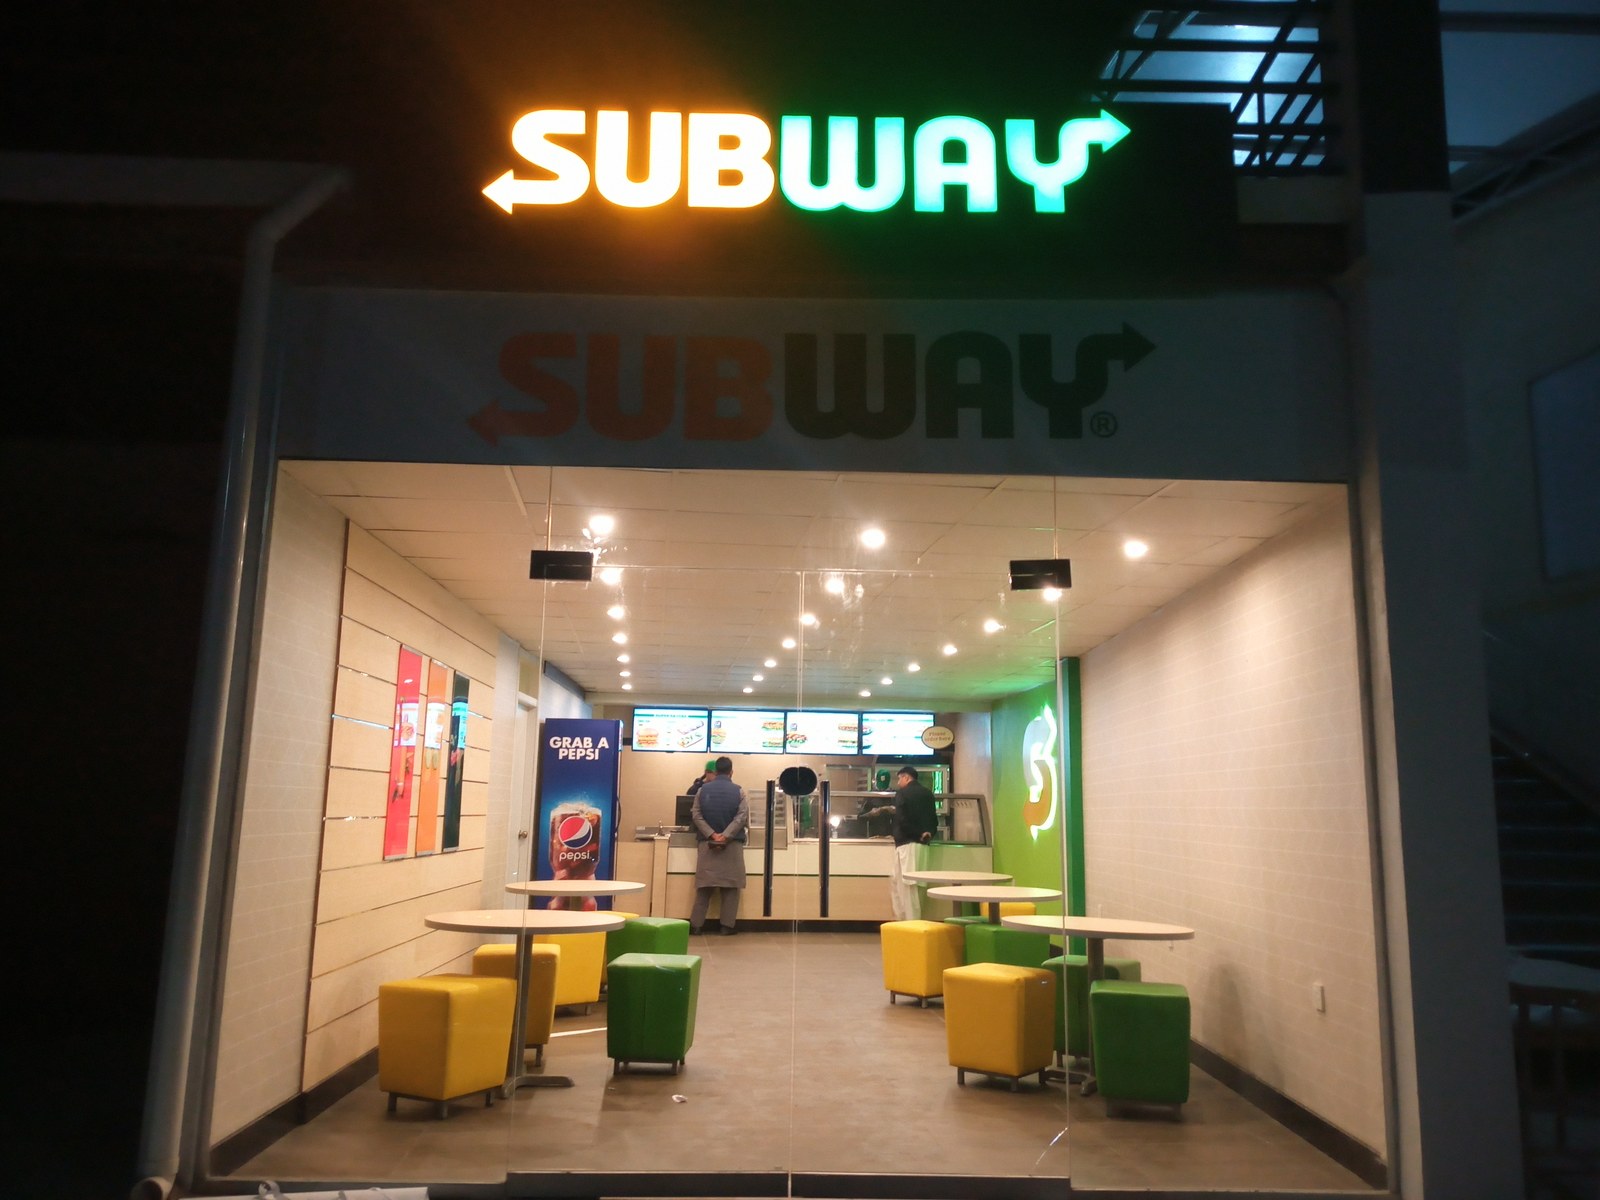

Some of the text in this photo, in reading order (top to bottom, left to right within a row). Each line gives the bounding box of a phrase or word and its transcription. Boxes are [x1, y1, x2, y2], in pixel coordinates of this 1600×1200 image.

[481, 108, 1131, 215] SUBWAY
[467, 322, 1157, 447] SUBWAY
[549, 736, 609, 748] GRAB A
[558, 748, 599, 760] PEPSI
[559, 850, 590, 862] pepsi
